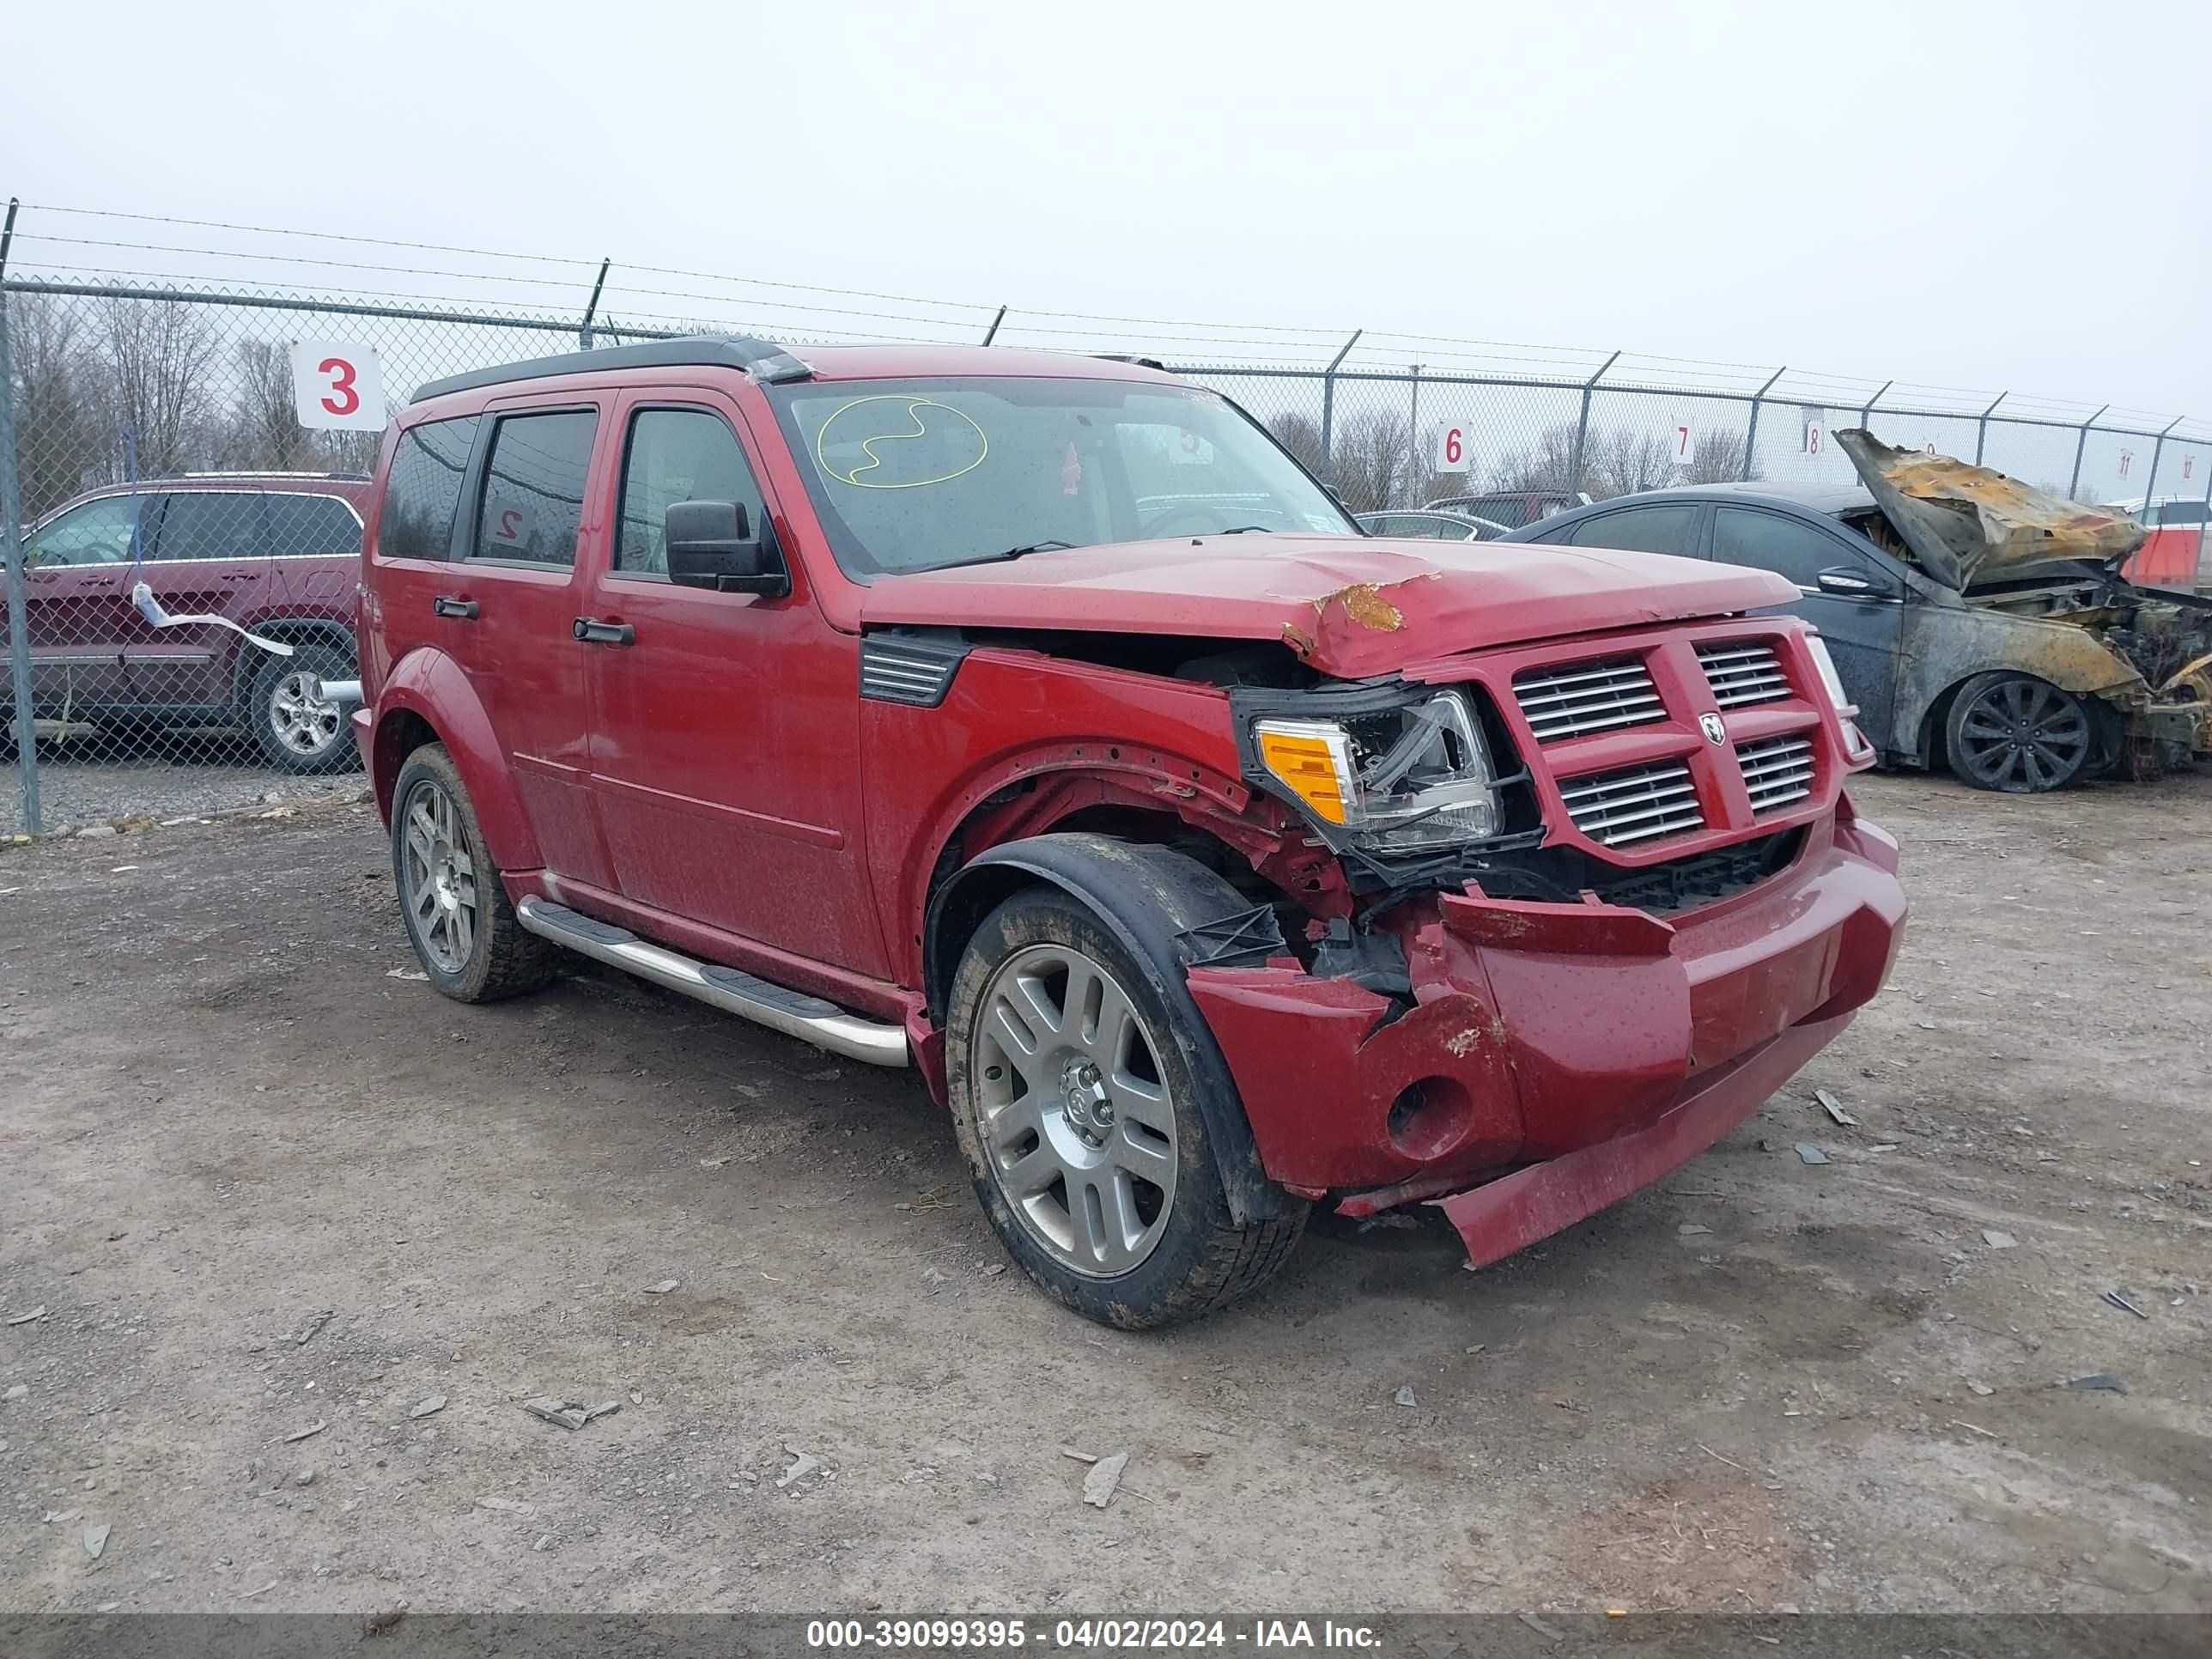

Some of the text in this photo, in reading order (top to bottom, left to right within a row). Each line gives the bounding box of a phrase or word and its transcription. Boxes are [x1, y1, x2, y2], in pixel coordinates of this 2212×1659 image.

[318, 357, 359, 416] 3
[1446, 428, 1462, 464] 6
[1678, 427, 1689, 456] 7
[1811, 428, 1819, 454] 8
[2119, 454, 2130, 475] 11
